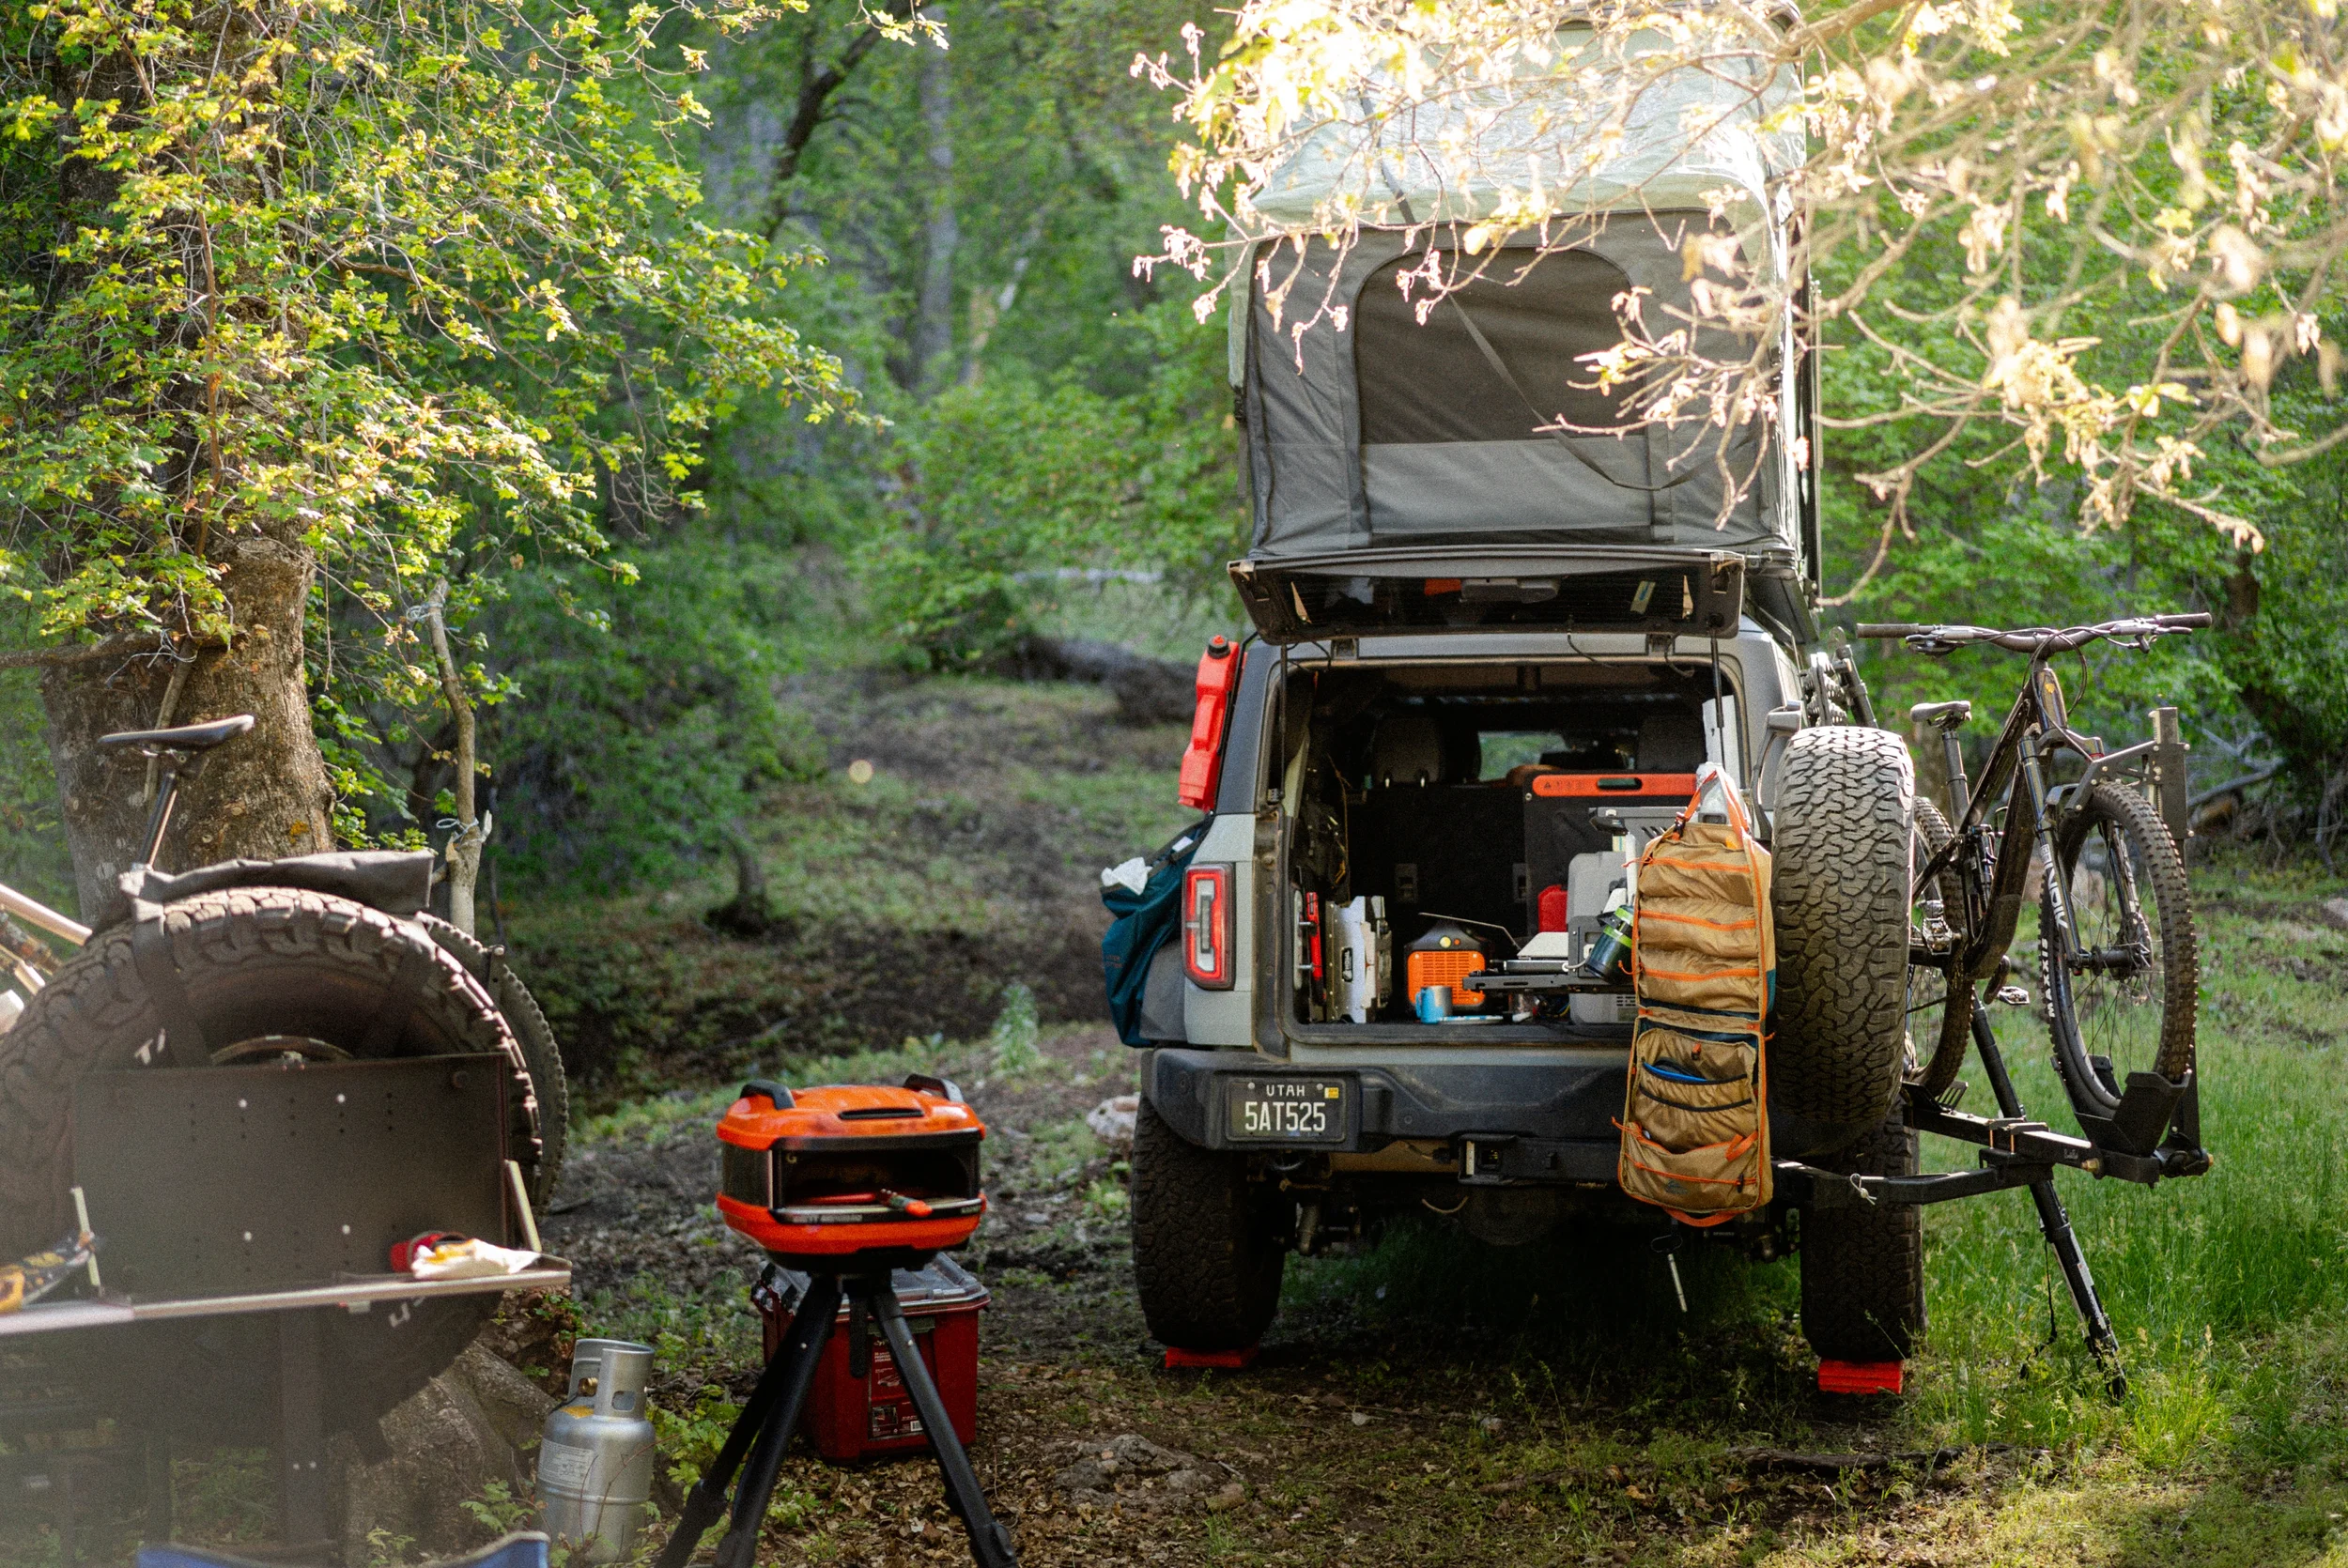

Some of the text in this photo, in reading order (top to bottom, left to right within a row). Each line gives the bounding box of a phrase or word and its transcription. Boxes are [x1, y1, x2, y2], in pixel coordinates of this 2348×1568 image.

[2041, 938, 2055, 1018] MAXXIS
[1266, 1084, 1305, 1097] UTAH
[1244, 1100, 1326, 1131] 5AT525
